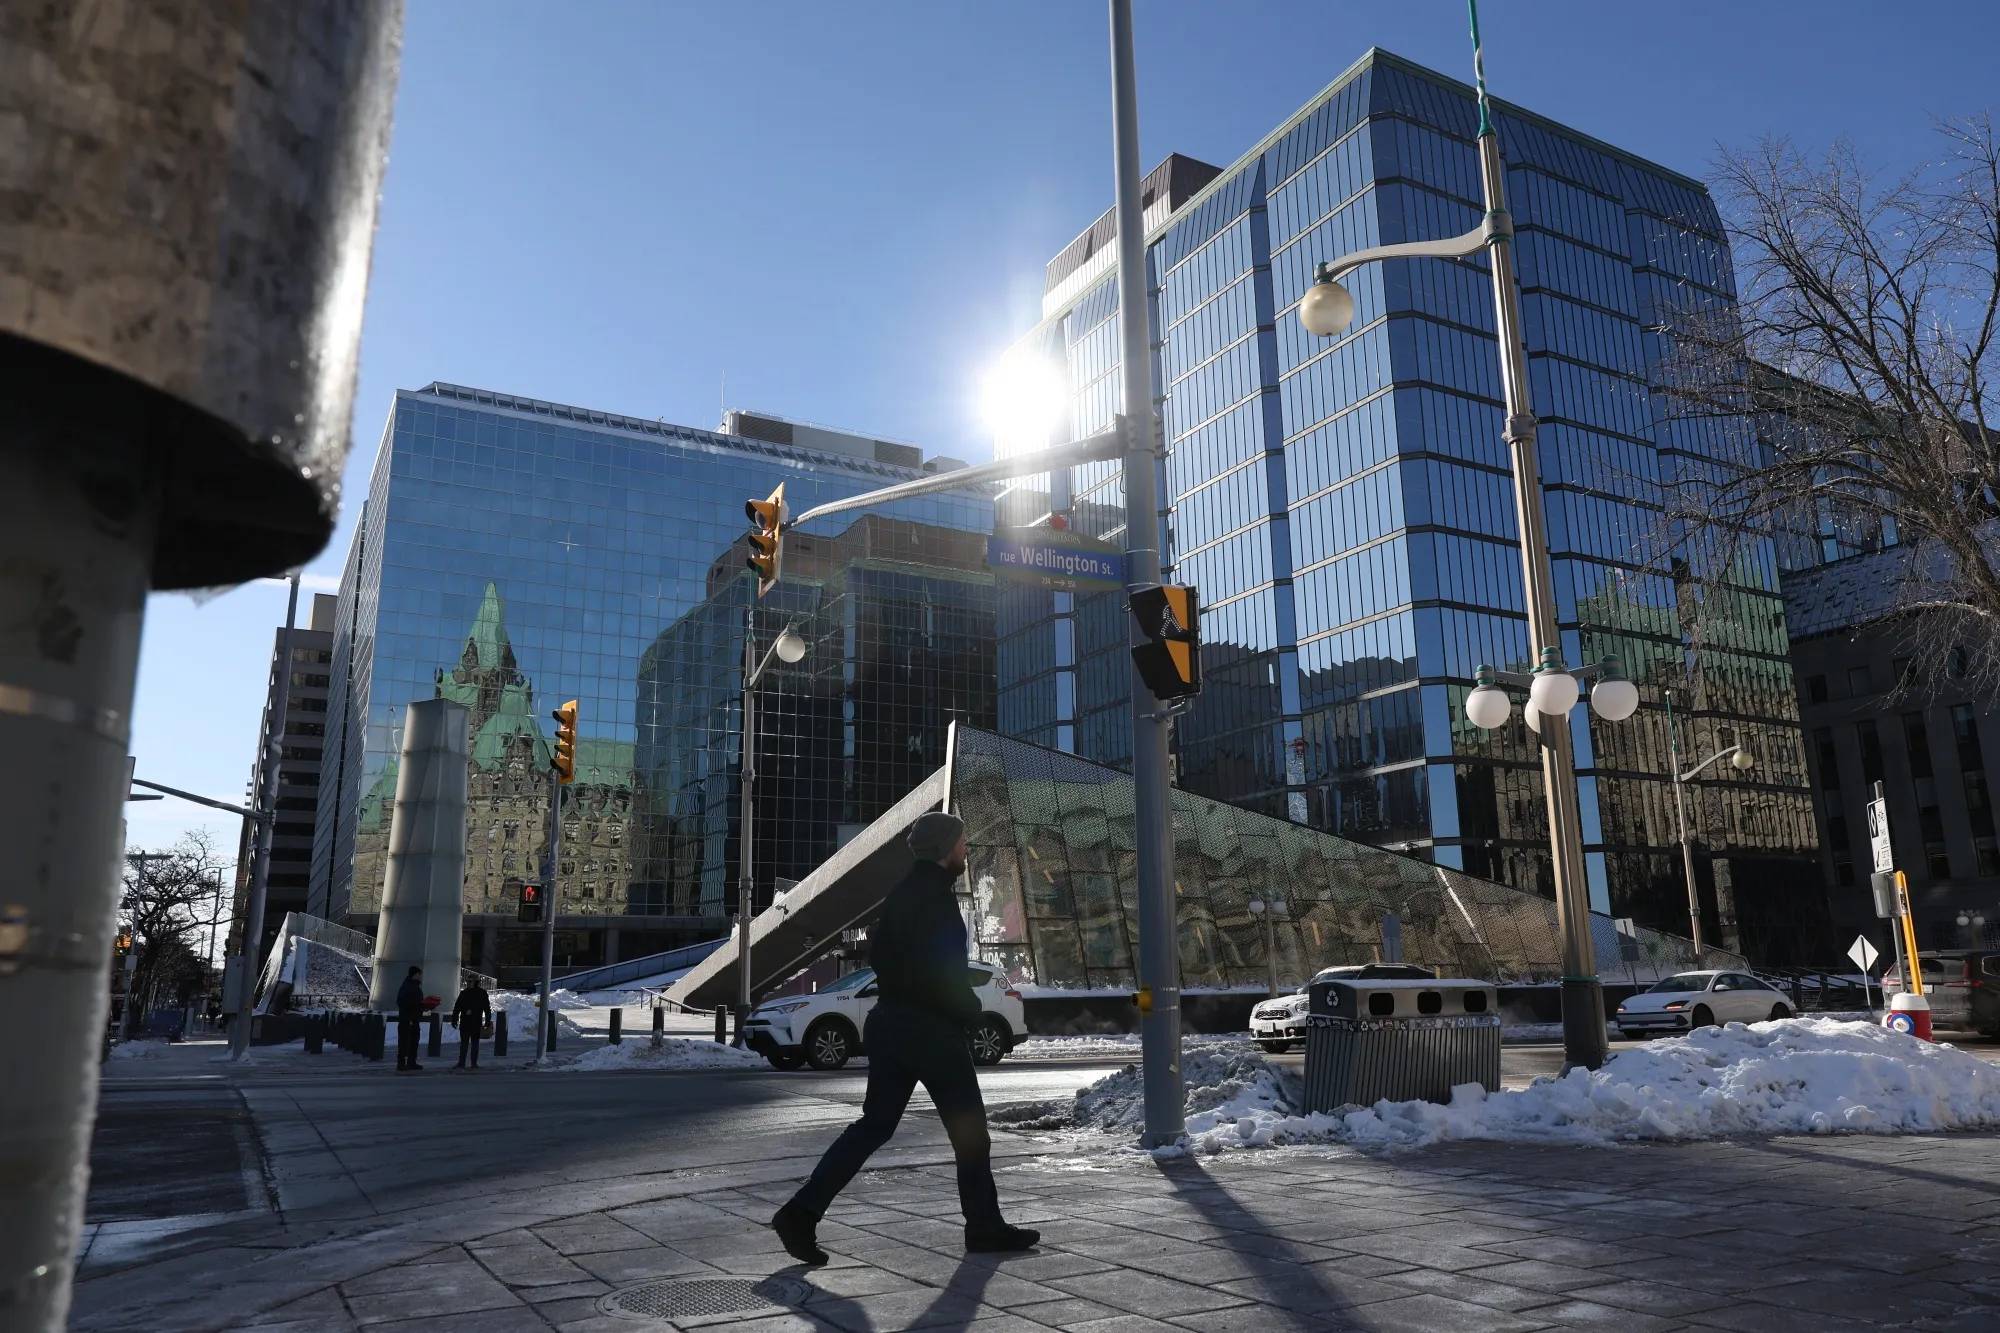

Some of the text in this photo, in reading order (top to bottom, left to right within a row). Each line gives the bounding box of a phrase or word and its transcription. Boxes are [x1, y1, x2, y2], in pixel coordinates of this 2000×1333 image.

[1000, 546, 1114, 575] rue Wellington St.
[850, 927, 868, 942] BANK
